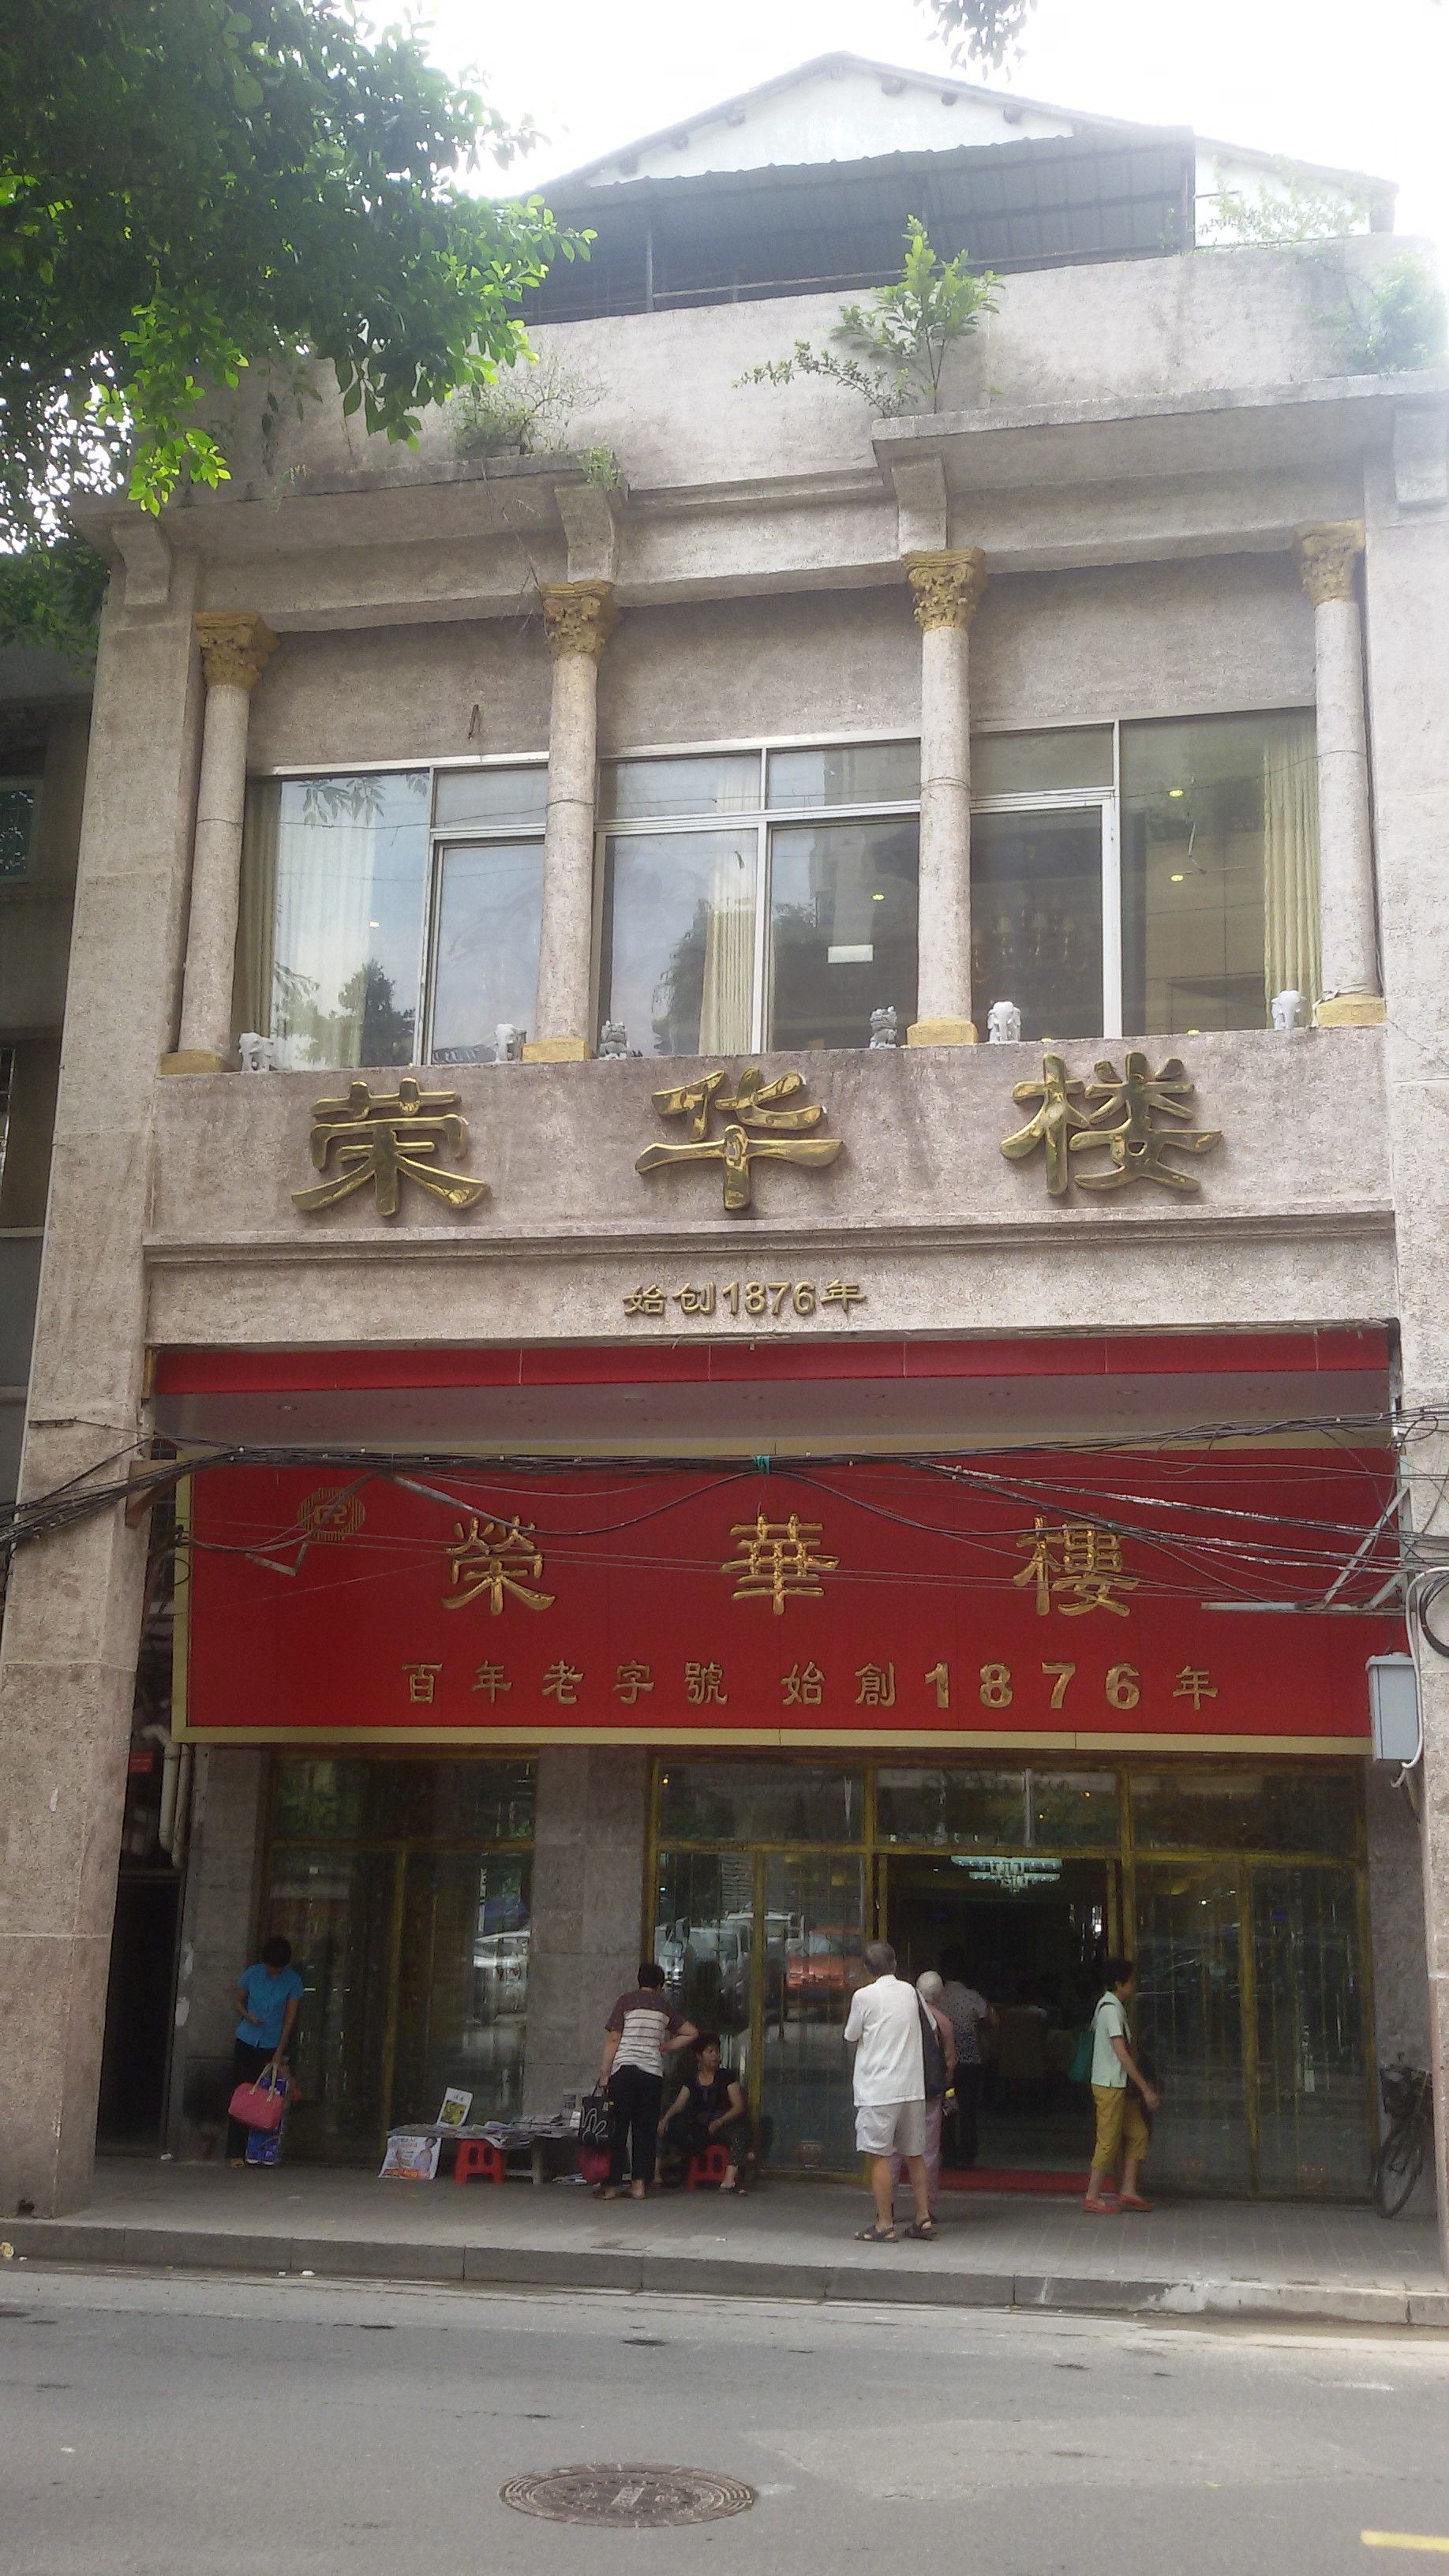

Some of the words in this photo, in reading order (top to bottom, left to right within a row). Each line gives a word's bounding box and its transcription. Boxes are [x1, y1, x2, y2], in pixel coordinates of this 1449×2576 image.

[290, 1050, 1224, 1216] 荣华楼
[622, 1279, 867, 1316] 始创1876年
[441, 1512, 1140, 1616] 榮華樓
[401, 1660, 729, 1705] 百年老字號
[780, 1661, 1219, 1711] 始創1876年
